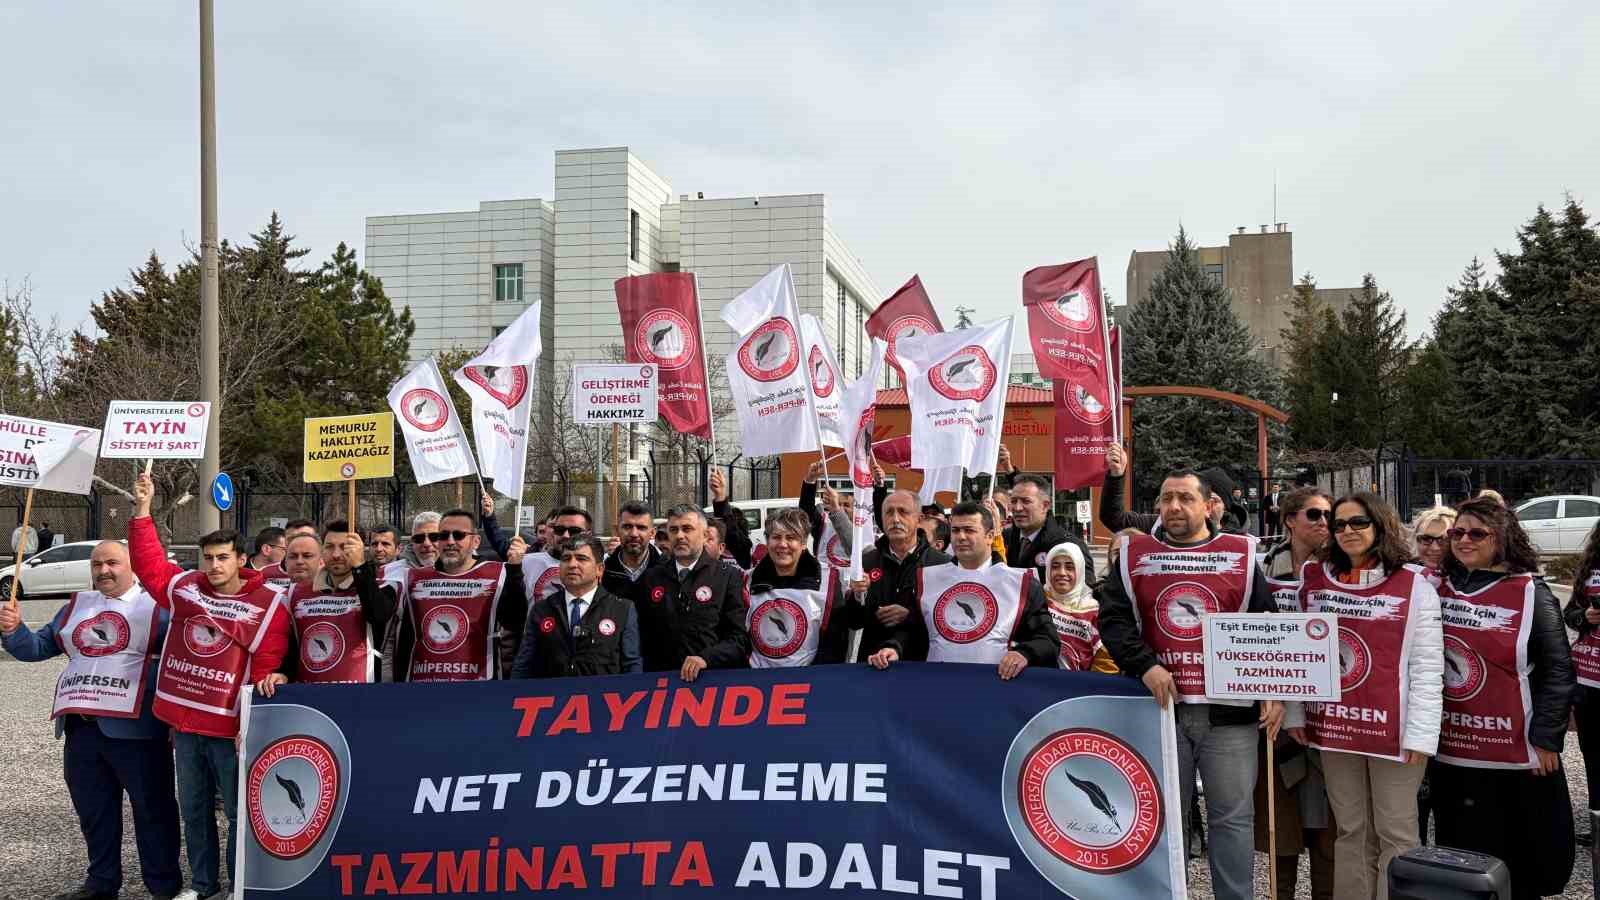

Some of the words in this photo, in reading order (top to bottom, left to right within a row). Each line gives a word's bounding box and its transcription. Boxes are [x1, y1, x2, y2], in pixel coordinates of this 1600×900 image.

[582, 378, 650, 391] GELİŞTİRME
[590, 392, 641, 404] ÖDENEĞİ
[587, 409, 645, 419] HAKKIMIZ
[0, 420, 47, 437] HÜLLE
[123, 418, 187, 434] TAYİN
[319, 421, 377, 435] MEMURUZ
[110, 440, 164, 449] SİSTEMİ
[167, 441, 200, 451] ŞART
[320, 434, 376, 447] HAKLIYIZ
[0, 449, 37, 465] SINA
[308, 445, 390, 461] KAZANACAĞIZ
[0, 464, 40, 480] İSTİY
[1149, 554, 1207, 562] HAKLARIMIZ
[1208, 554, 1228, 563] İÇİN
[1160, 564, 1217, 572] BURADAYIZ!
[1474, 607, 1497, 619] İÇİN
[1216, 622, 1240, 632] "Eşit
[1242, 622, 1277, 633] Emeğe
[1280, 623, 1299, 633] Eşit
[1229, 635, 1286, 645] Tazminat!"
[1156, 648, 1204, 665] NİPER
[1216, 648, 1326, 663] YÜKSEKÖĞRETİM
[166, 654, 236, 685] ÜNİPERSEN
[1235, 666, 1307, 678] TAZMİNATI
[61, 673, 130, 690] ÜNİPERSEN
[1227, 682, 1318, 695] HAKKIMIZDIR
[512, 678, 812, 737] TAYİNDE
[1441, 710, 1513, 731] PERSEN
[287, 743, 331, 776] PERSONEL
[412, 772, 522, 814] NET
[535, 758, 888, 809] DÜZENLEME
[1027, 766, 1061, 845] ÜNİVERSİTE
[1074, 738, 1140, 781] PERSONEL
[1123, 781, 1154, 855] SENDİKASI
[304, 775, 334, 841] SENDİKASI
[275, 841, 296, 852] 2015
[1076, 850, 1109, 865] 2015
[330, 836, 715, 896] TAZMİNATTA
[735, 841, 1010, 900] ADALET
